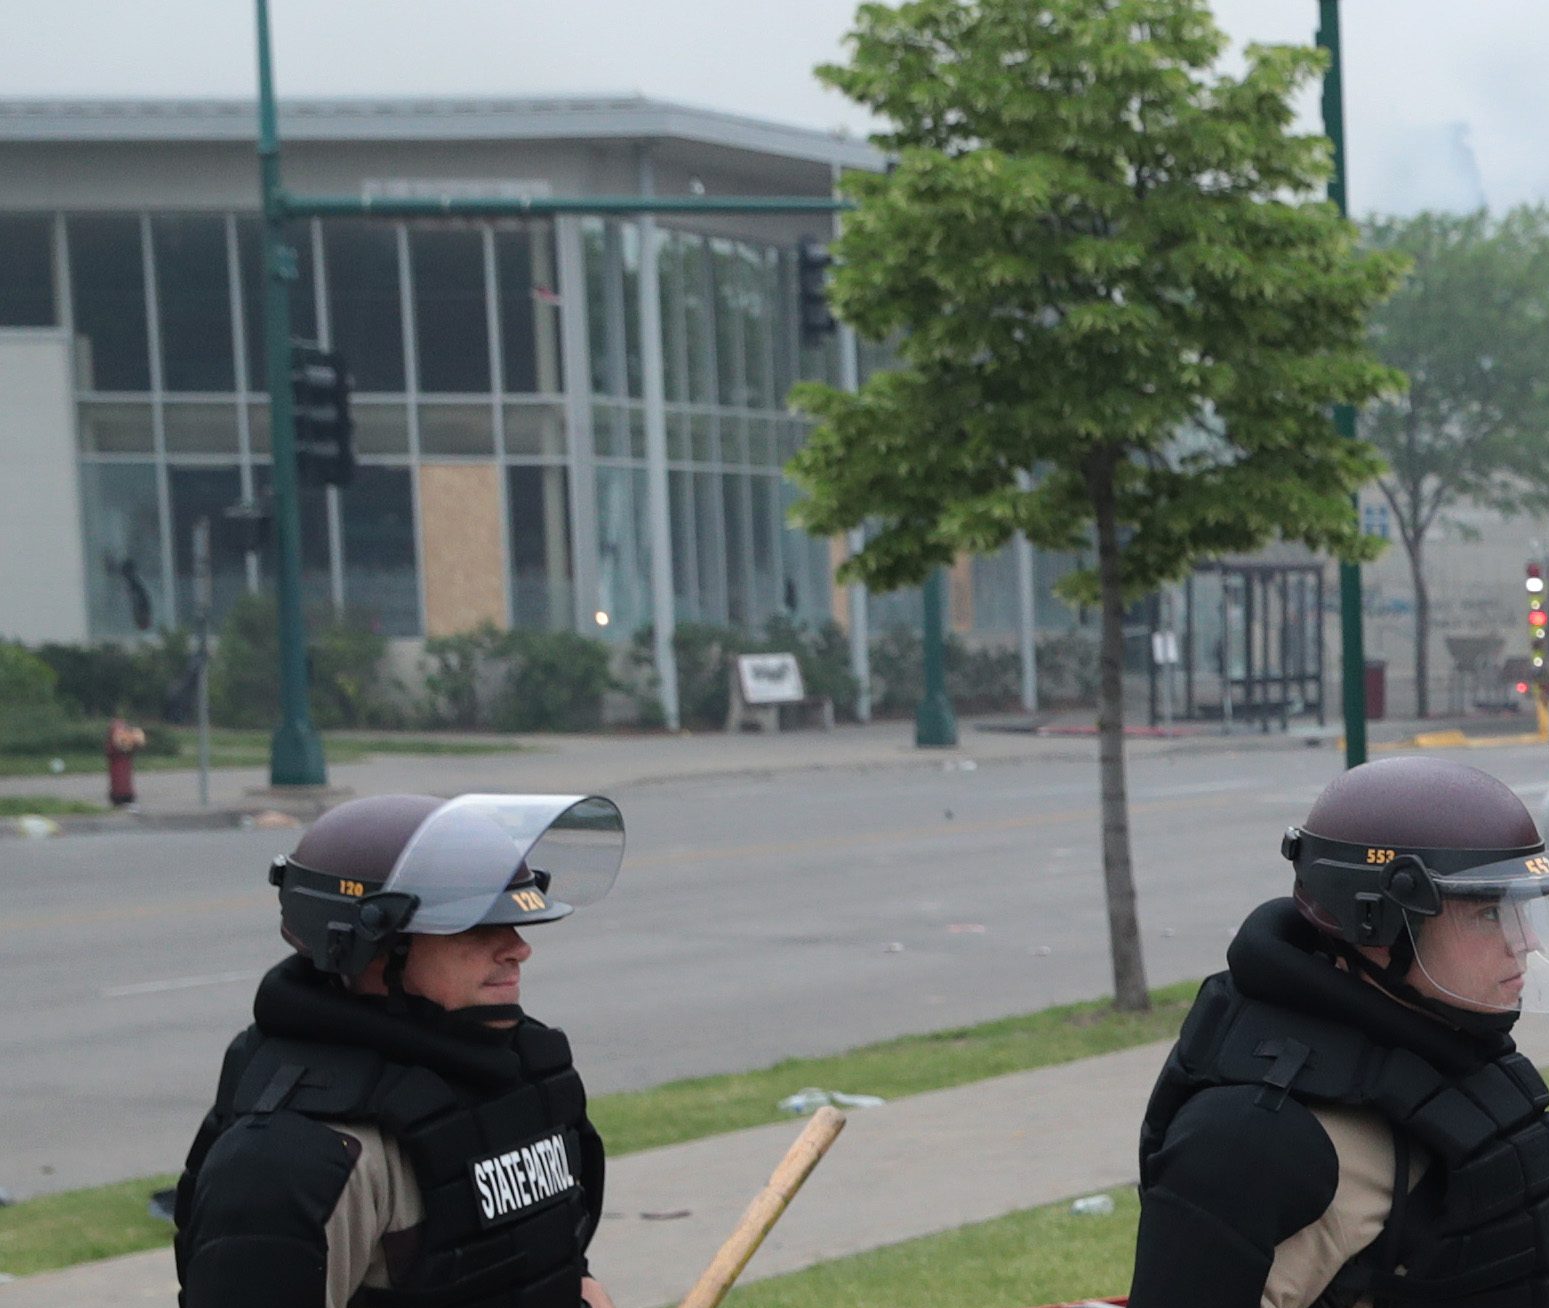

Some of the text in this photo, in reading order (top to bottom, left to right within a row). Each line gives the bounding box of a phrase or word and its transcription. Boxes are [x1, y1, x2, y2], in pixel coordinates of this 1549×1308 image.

[1366, 848, 1396, 864] 553
[339, 879, 364, 897] 120
[512, 891, 546, 912] 120
[474, 1133, 575, 1220] STATE PATROL
